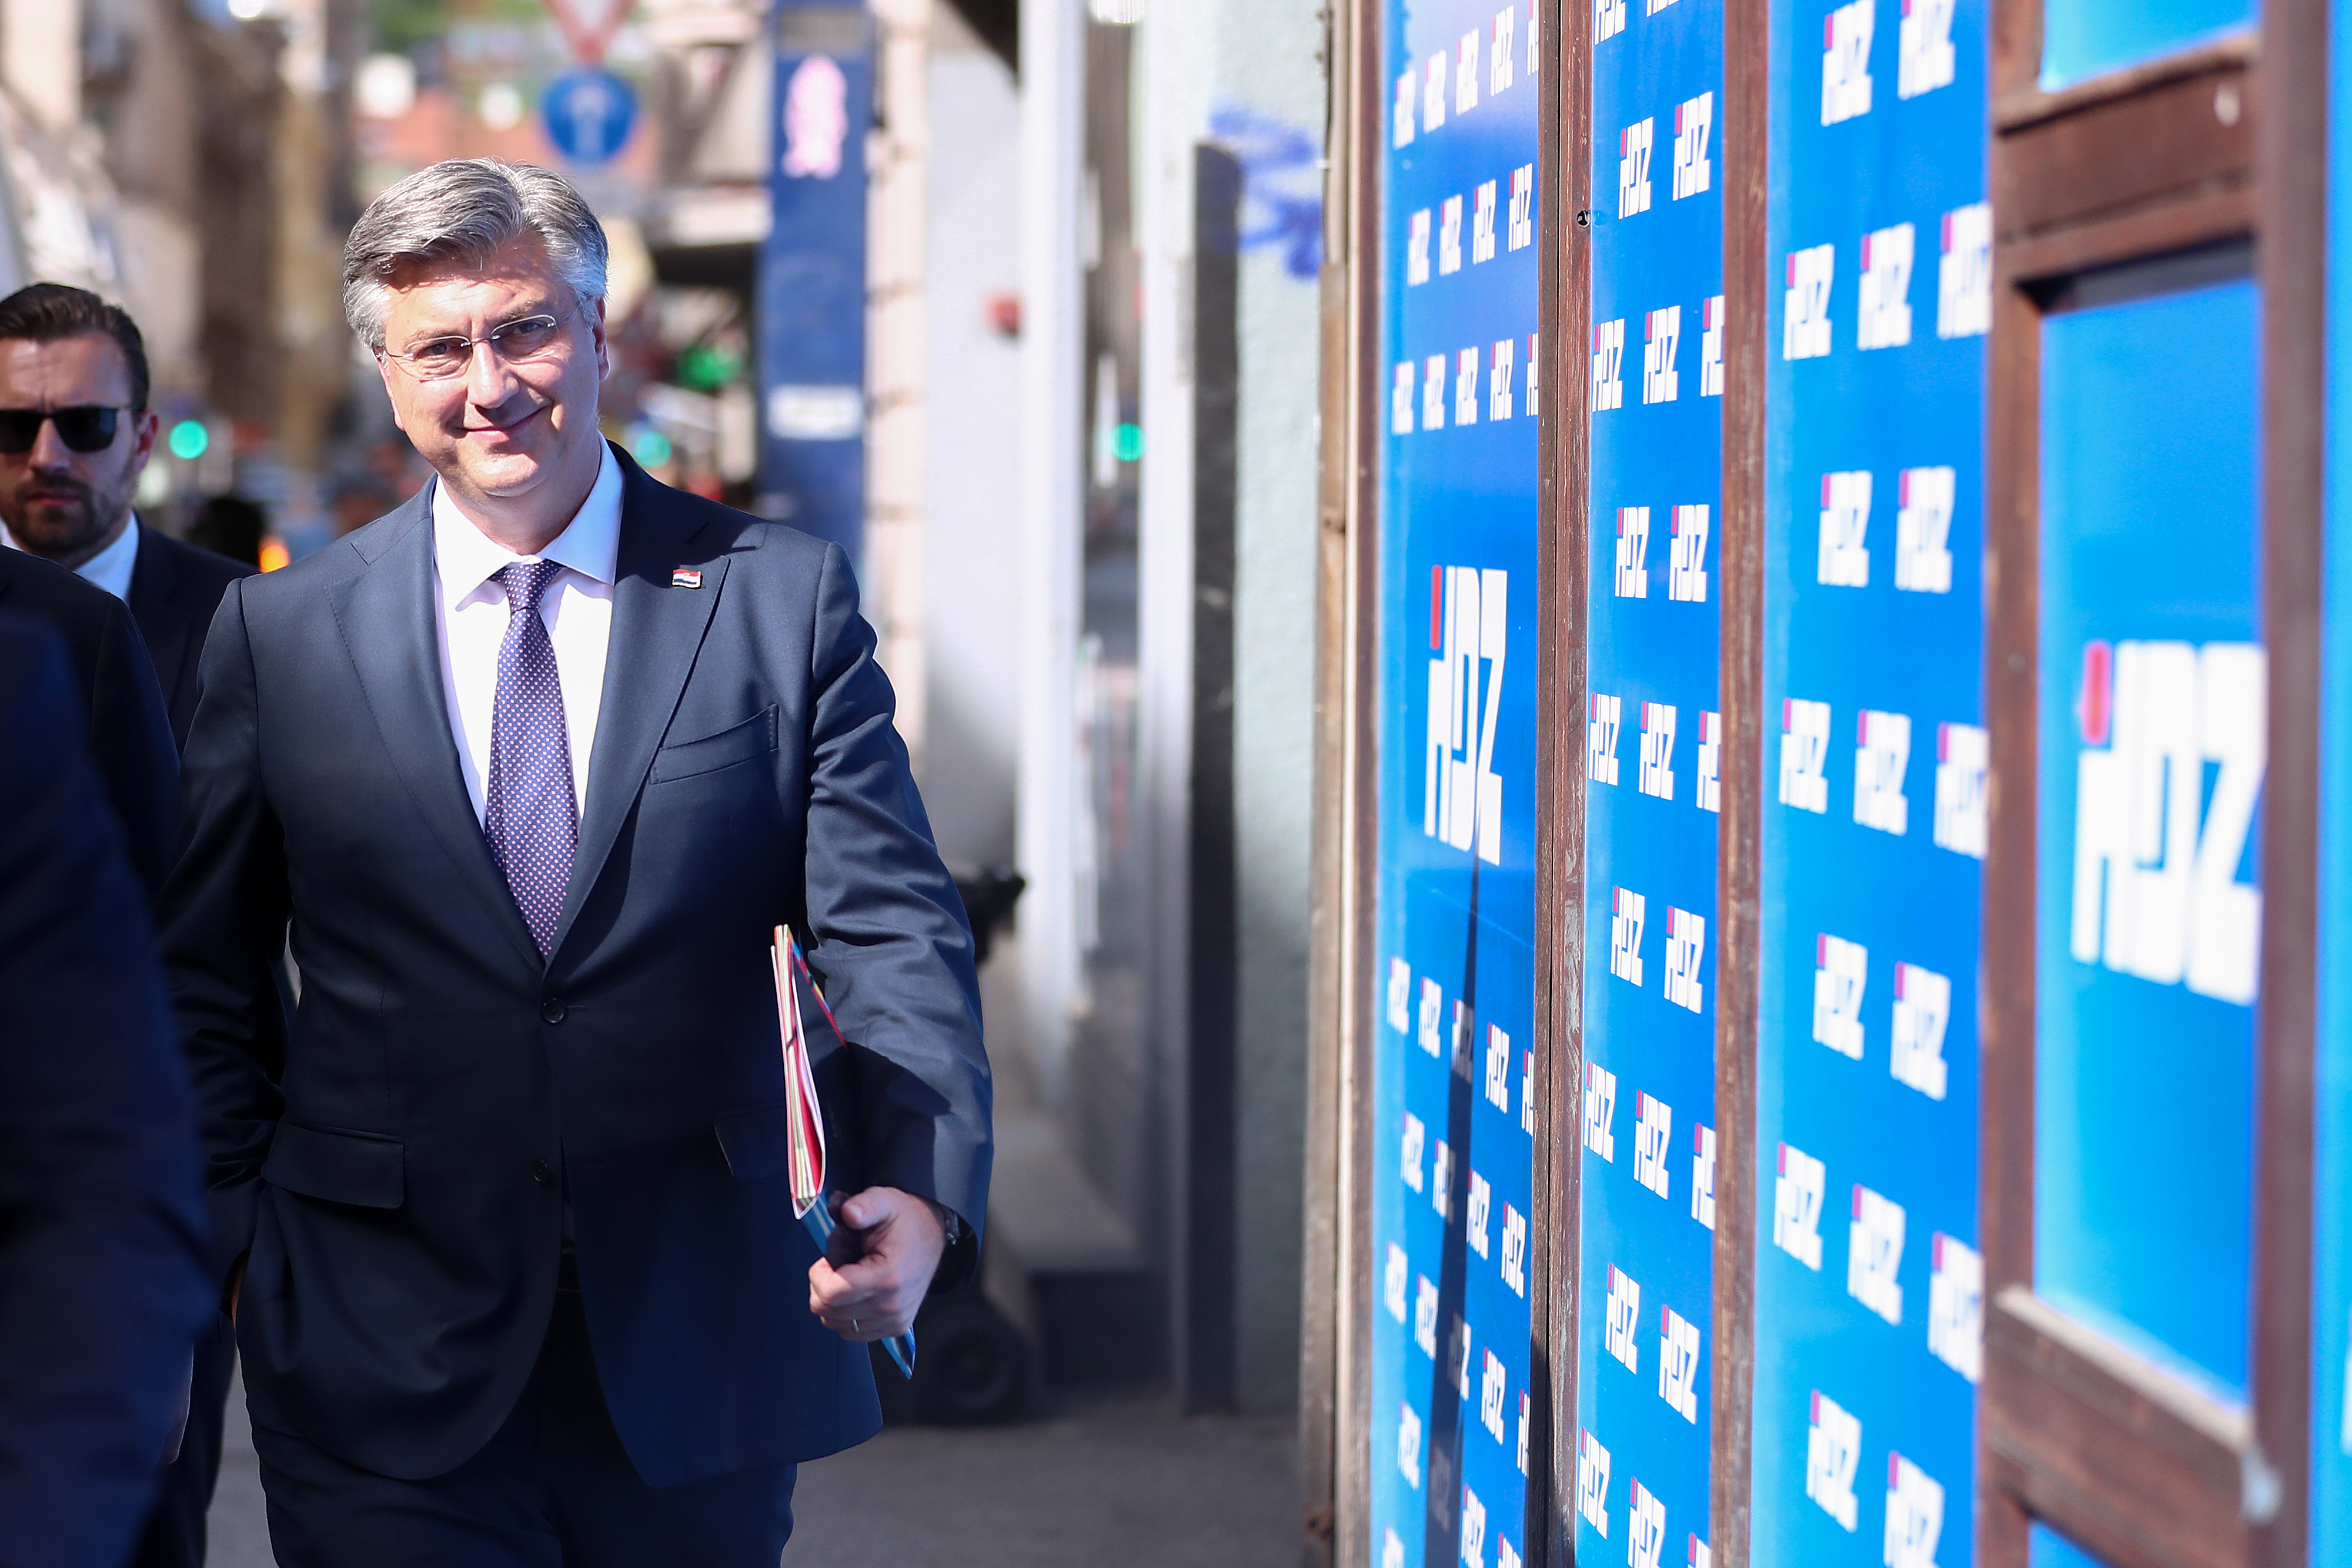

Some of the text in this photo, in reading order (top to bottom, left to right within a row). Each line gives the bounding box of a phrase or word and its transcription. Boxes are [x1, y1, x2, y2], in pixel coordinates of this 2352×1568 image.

[1619, 117, 1653, 219] HDZ
[1672, 92, 1712, 200] HDZ
[1508, 163, 1533, 252] HDZ
[1490, 339, 1514, 422] HDZ
[1592, 319, 1625, 412] HDZ
[1643, 306, 1681, 405] HDZ
[1615, 507, 1649, 599] HDZ
[1669, 504, 1709, 602] HDZ
[1425, 564, 1508, 866] HDZ
[1588, 693, 1621, 786] HDZ
[1638, 701, 1676, 800] HDZ
[2070, 640, 2269, 1006] HDZ
[1611, 885, 1645, 987] HDZ
[1664, 905, 1705, 1014] HDZ
[1485, 1022, 1510, 1114] HDZ
[1583, 1061, 1616, 1164] HDZ
[1633, 1089, 1672, 1199] HDZ
[1501, 1201, 1526, 1299] HDZ
[1605, 1262, 1640, 1374] HDZ
[1658, 1304, 1700, 1425] HDZ
[1481, 1346, 1506, 1445] HDZ
[1578, 1427, 1611, 1539] HDZ
